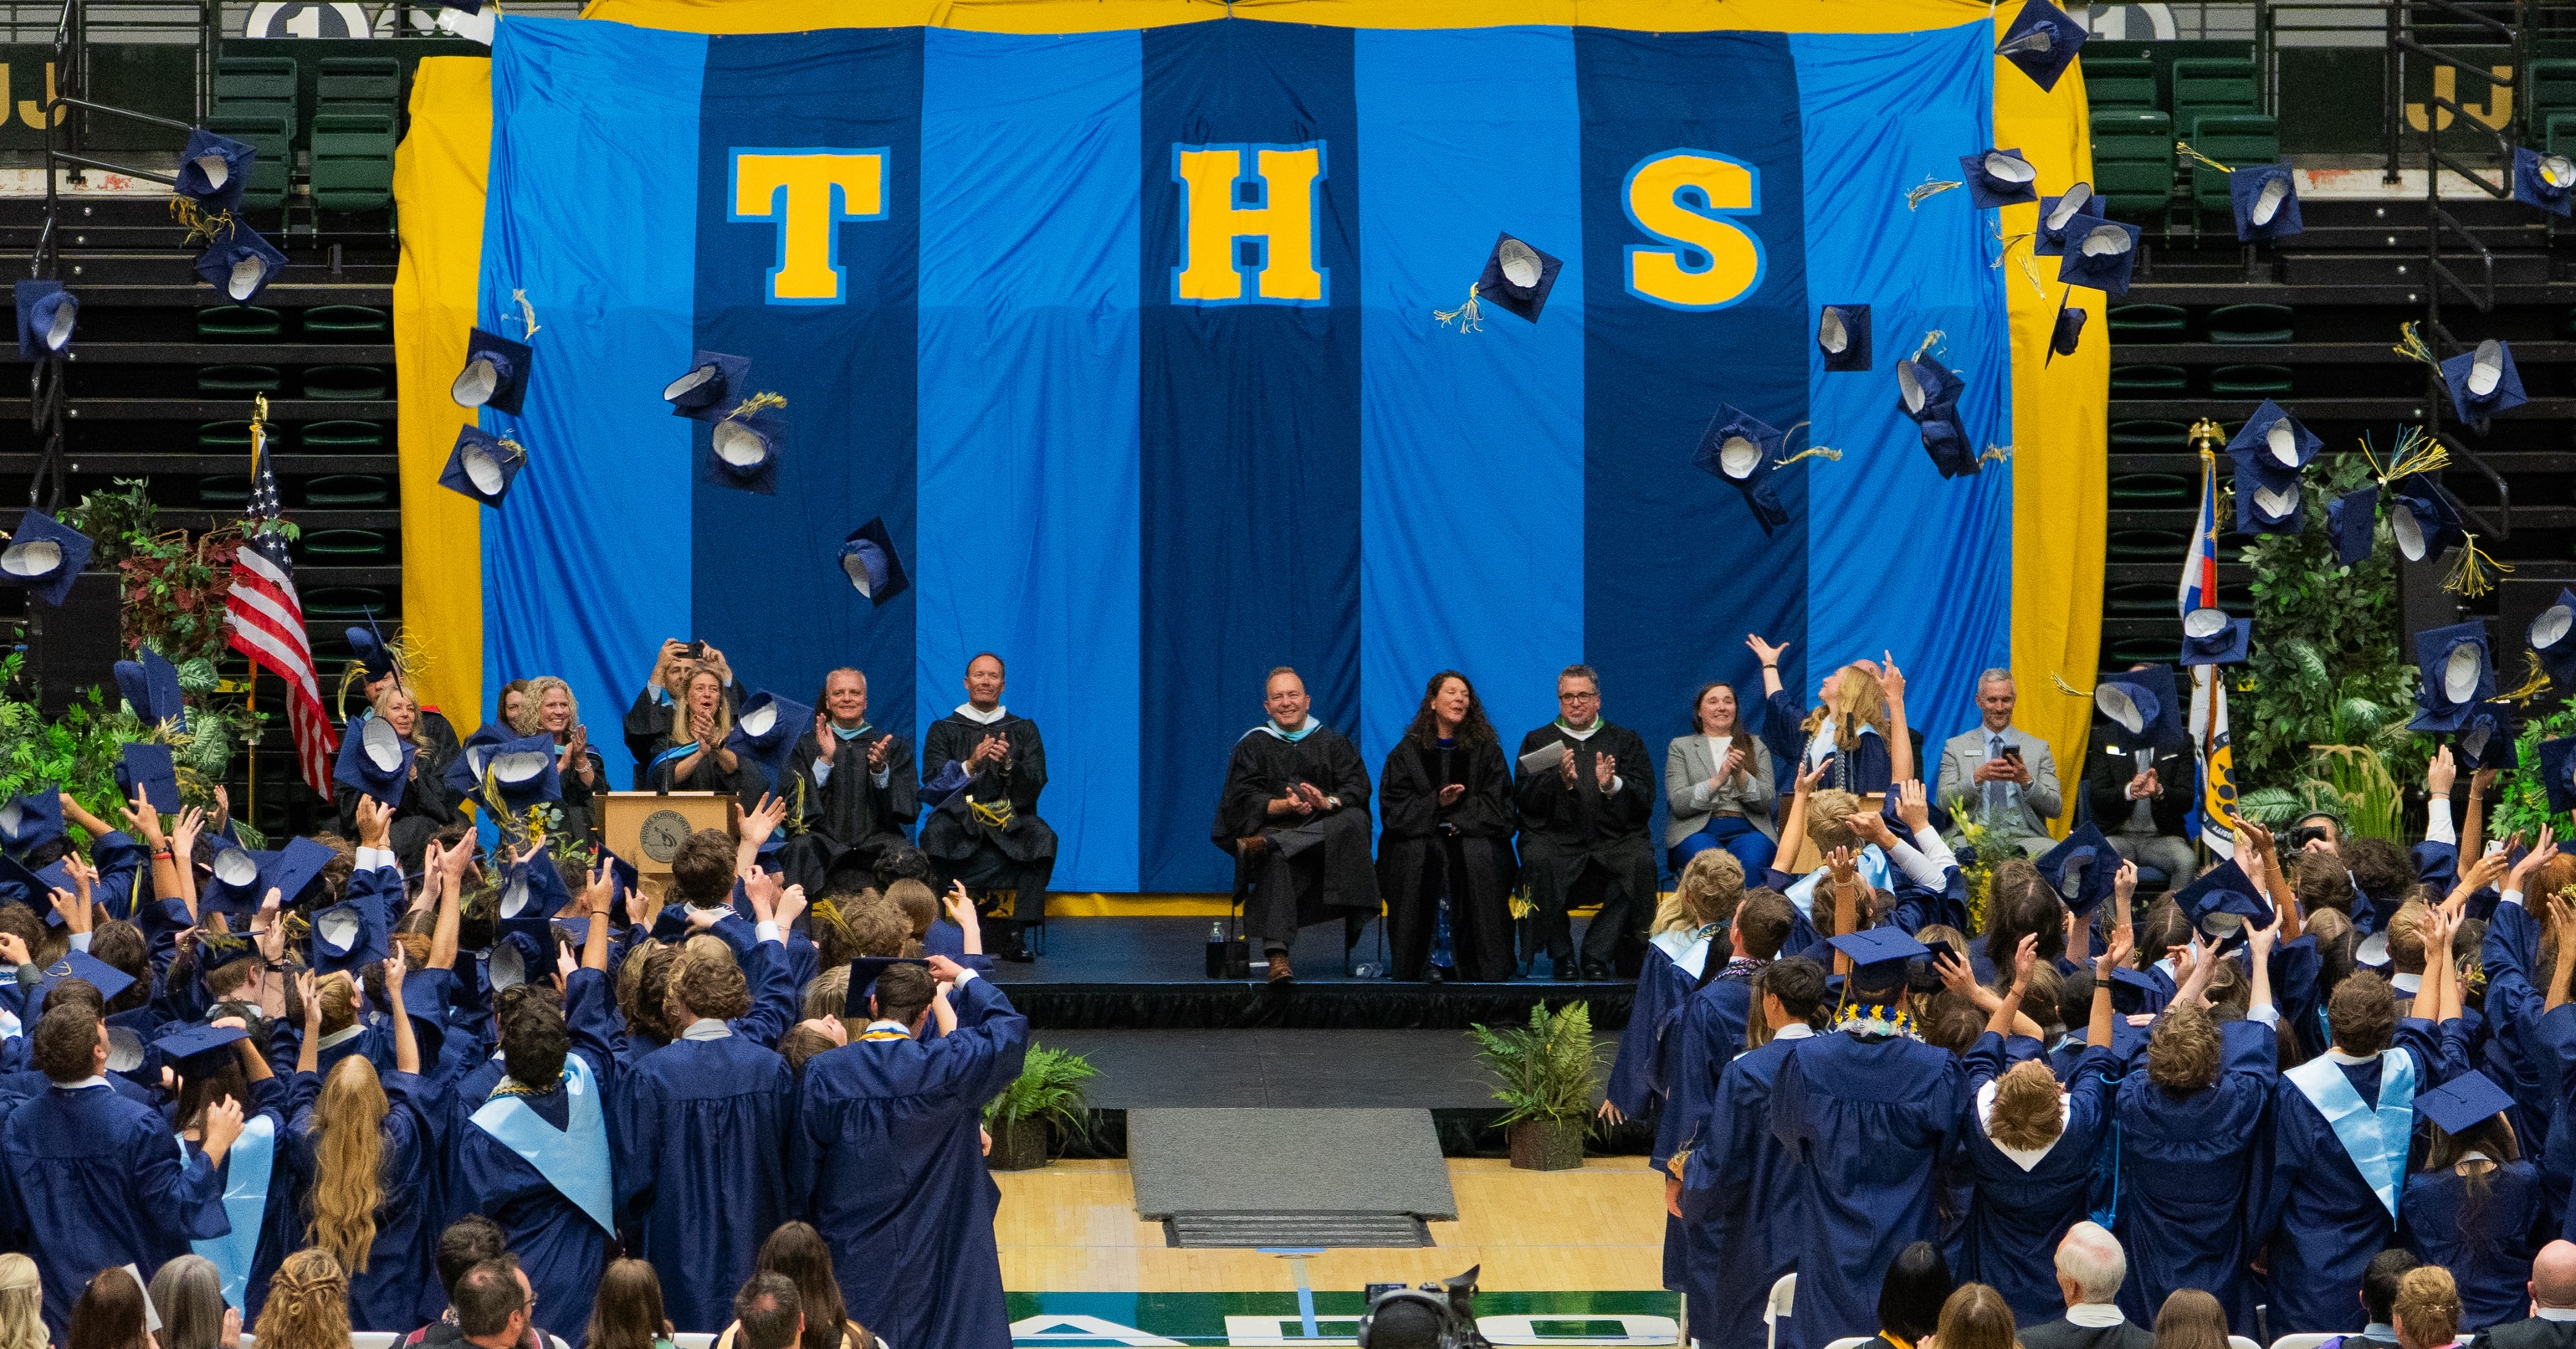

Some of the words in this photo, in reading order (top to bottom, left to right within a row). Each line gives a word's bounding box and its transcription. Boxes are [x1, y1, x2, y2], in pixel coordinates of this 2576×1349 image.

[642, 818, 653, 845] POUDRE
[653, 812, 679, 821] SCHOOL
[678, 817, 691, 837] DISTRI
